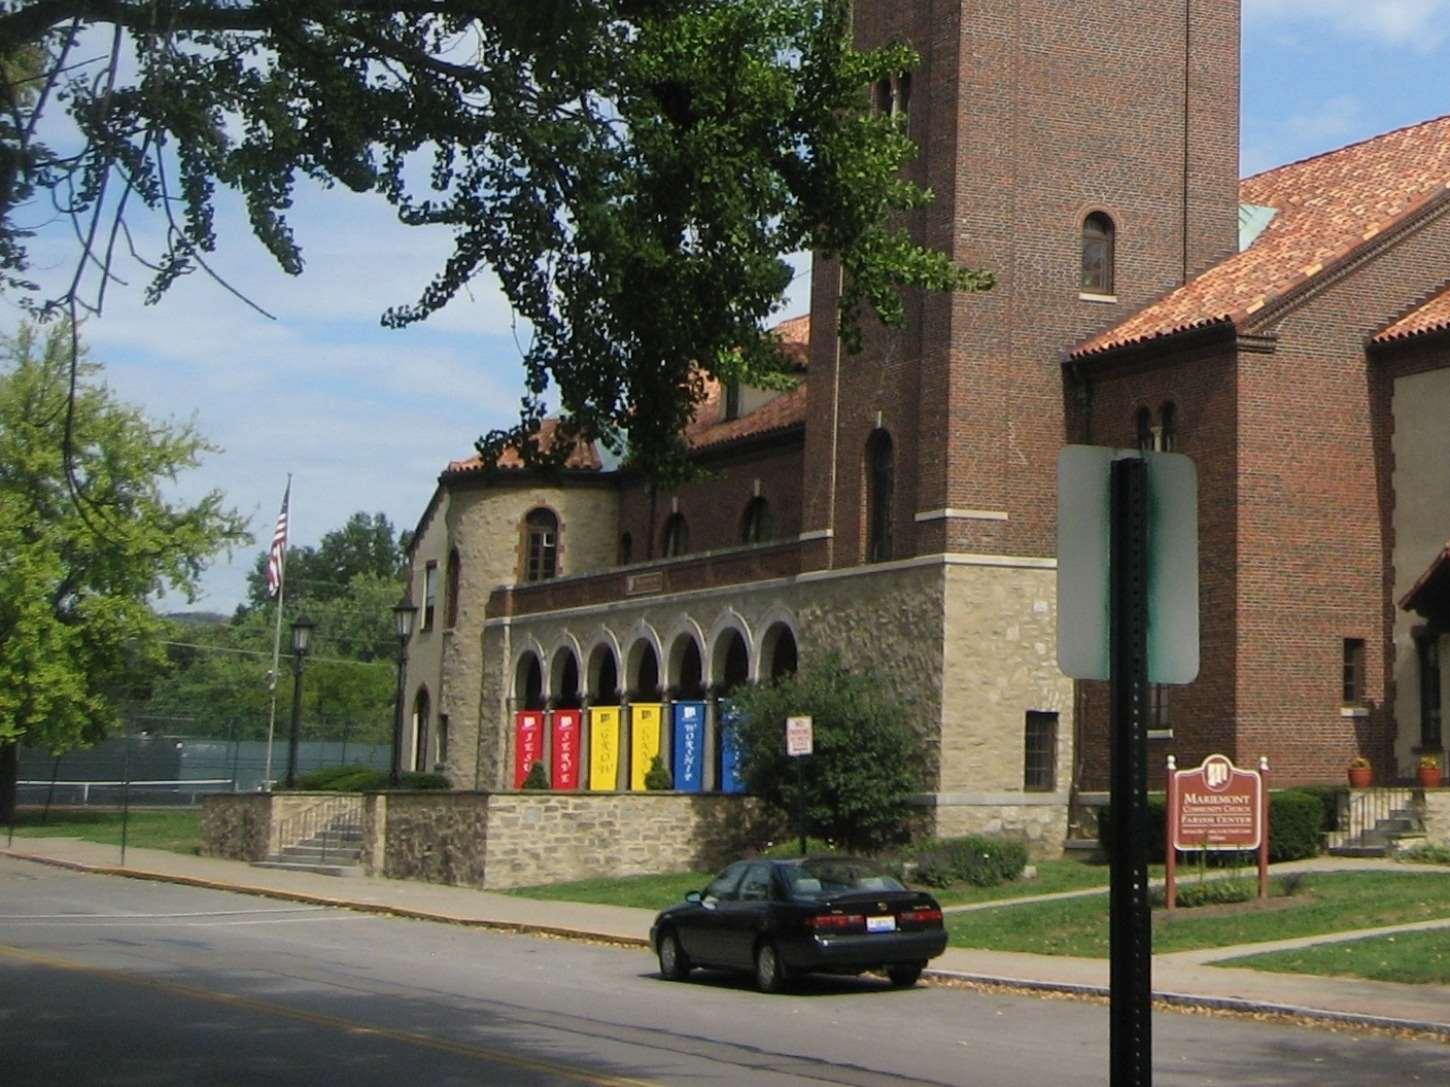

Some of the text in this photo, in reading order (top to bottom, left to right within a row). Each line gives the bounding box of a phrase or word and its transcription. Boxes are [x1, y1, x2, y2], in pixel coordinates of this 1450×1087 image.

[560, 731, 572, 784] SERVE
[683, 723, 698, 782] WORSHIP
[1184, 793, 1249, 804] MARIEMONT
[1216, 816, 1252, 824] CENTER
